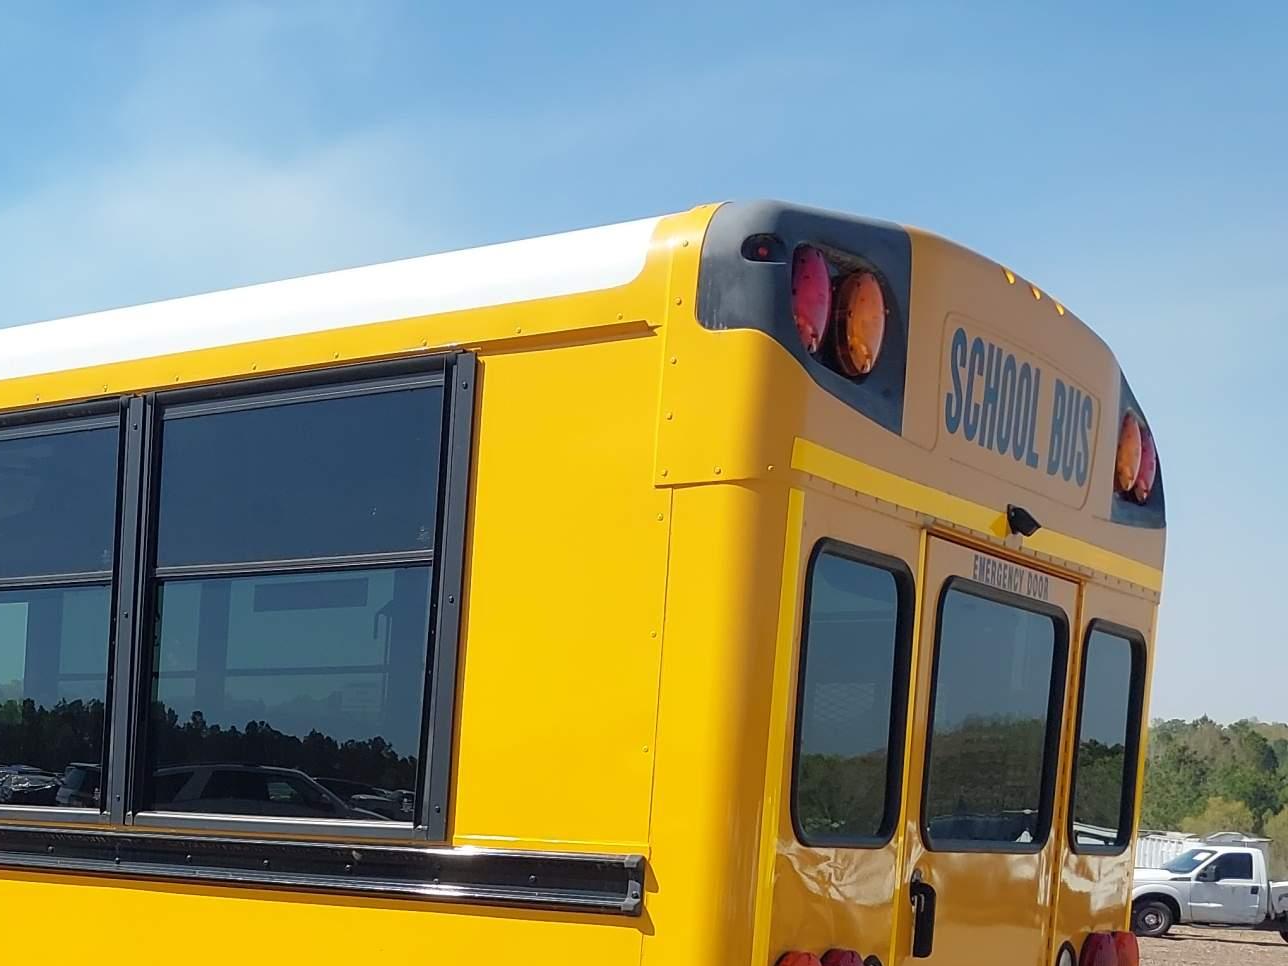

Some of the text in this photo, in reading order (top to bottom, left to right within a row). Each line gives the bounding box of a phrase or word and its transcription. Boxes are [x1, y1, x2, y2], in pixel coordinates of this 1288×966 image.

[945, 328, 1093, 487] SCHOOL BUS
[973, 554, 1049, 600] EMERGENCY DOOR
